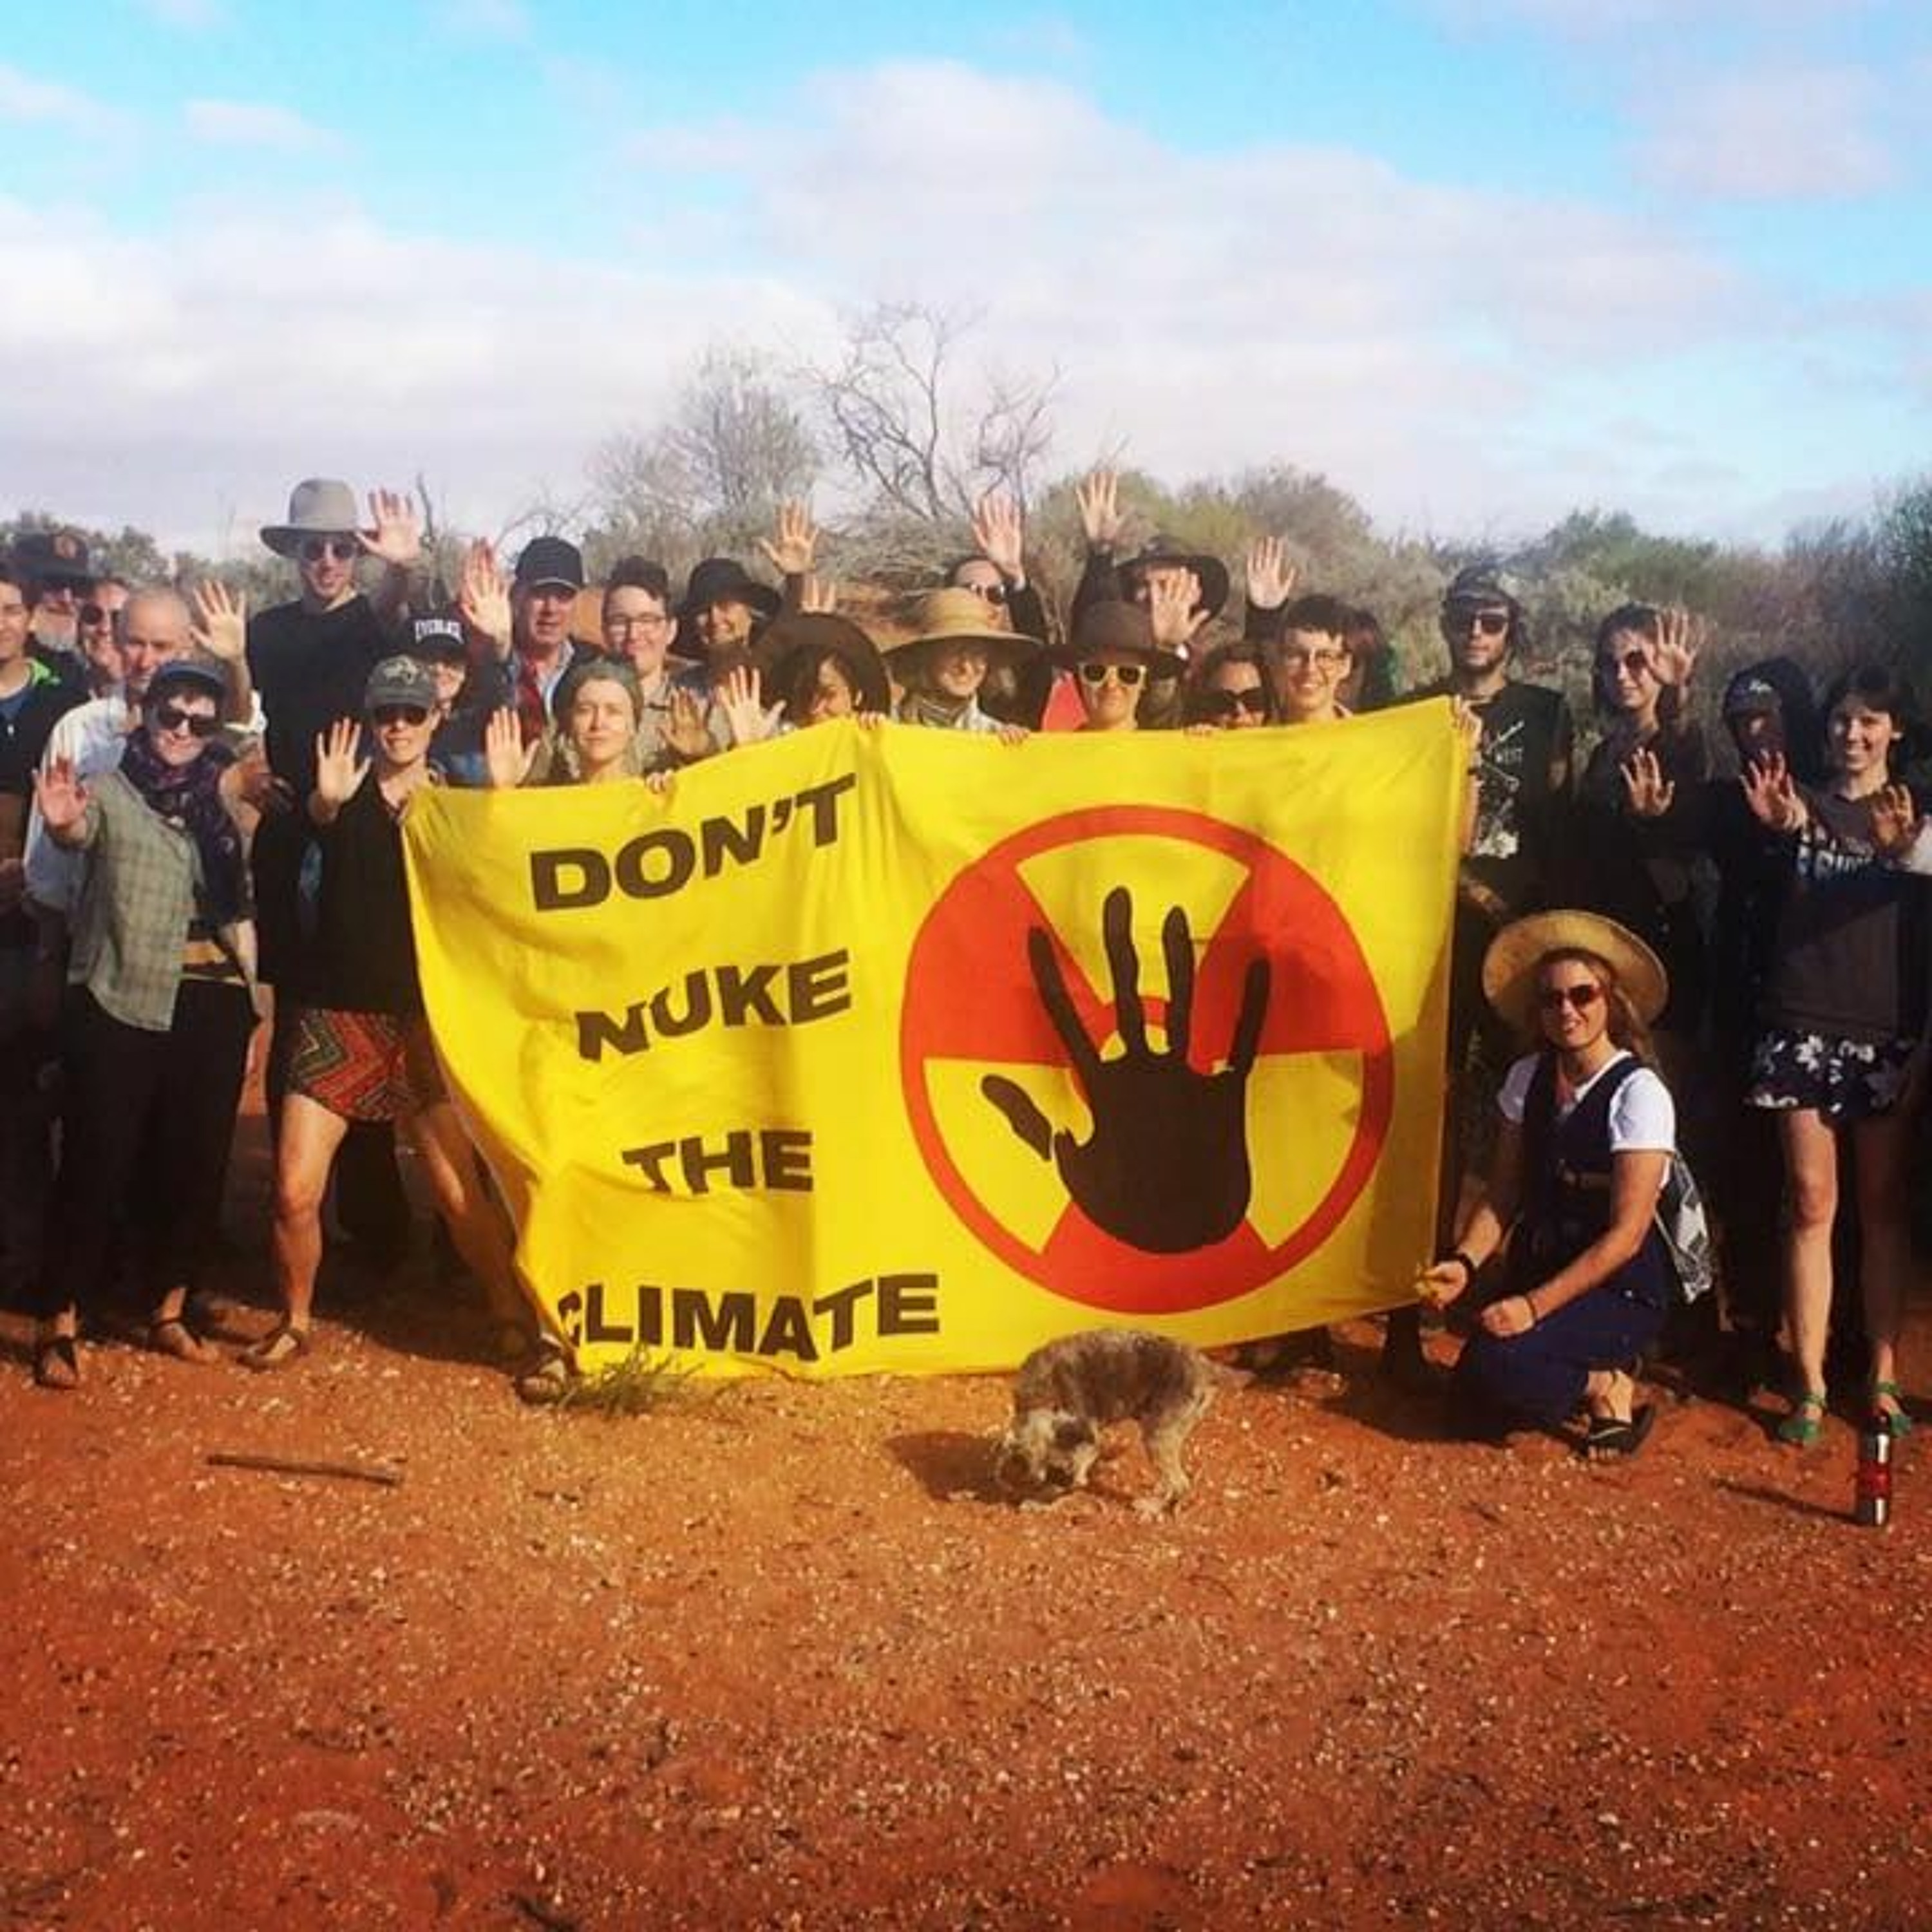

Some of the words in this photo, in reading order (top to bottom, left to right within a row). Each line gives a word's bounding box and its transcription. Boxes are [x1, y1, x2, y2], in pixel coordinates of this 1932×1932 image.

[530, 773, 856, 911] DON'T
[575, 949, 852, 1063] NUKE
[622, 1130, 813, 1195] THE
